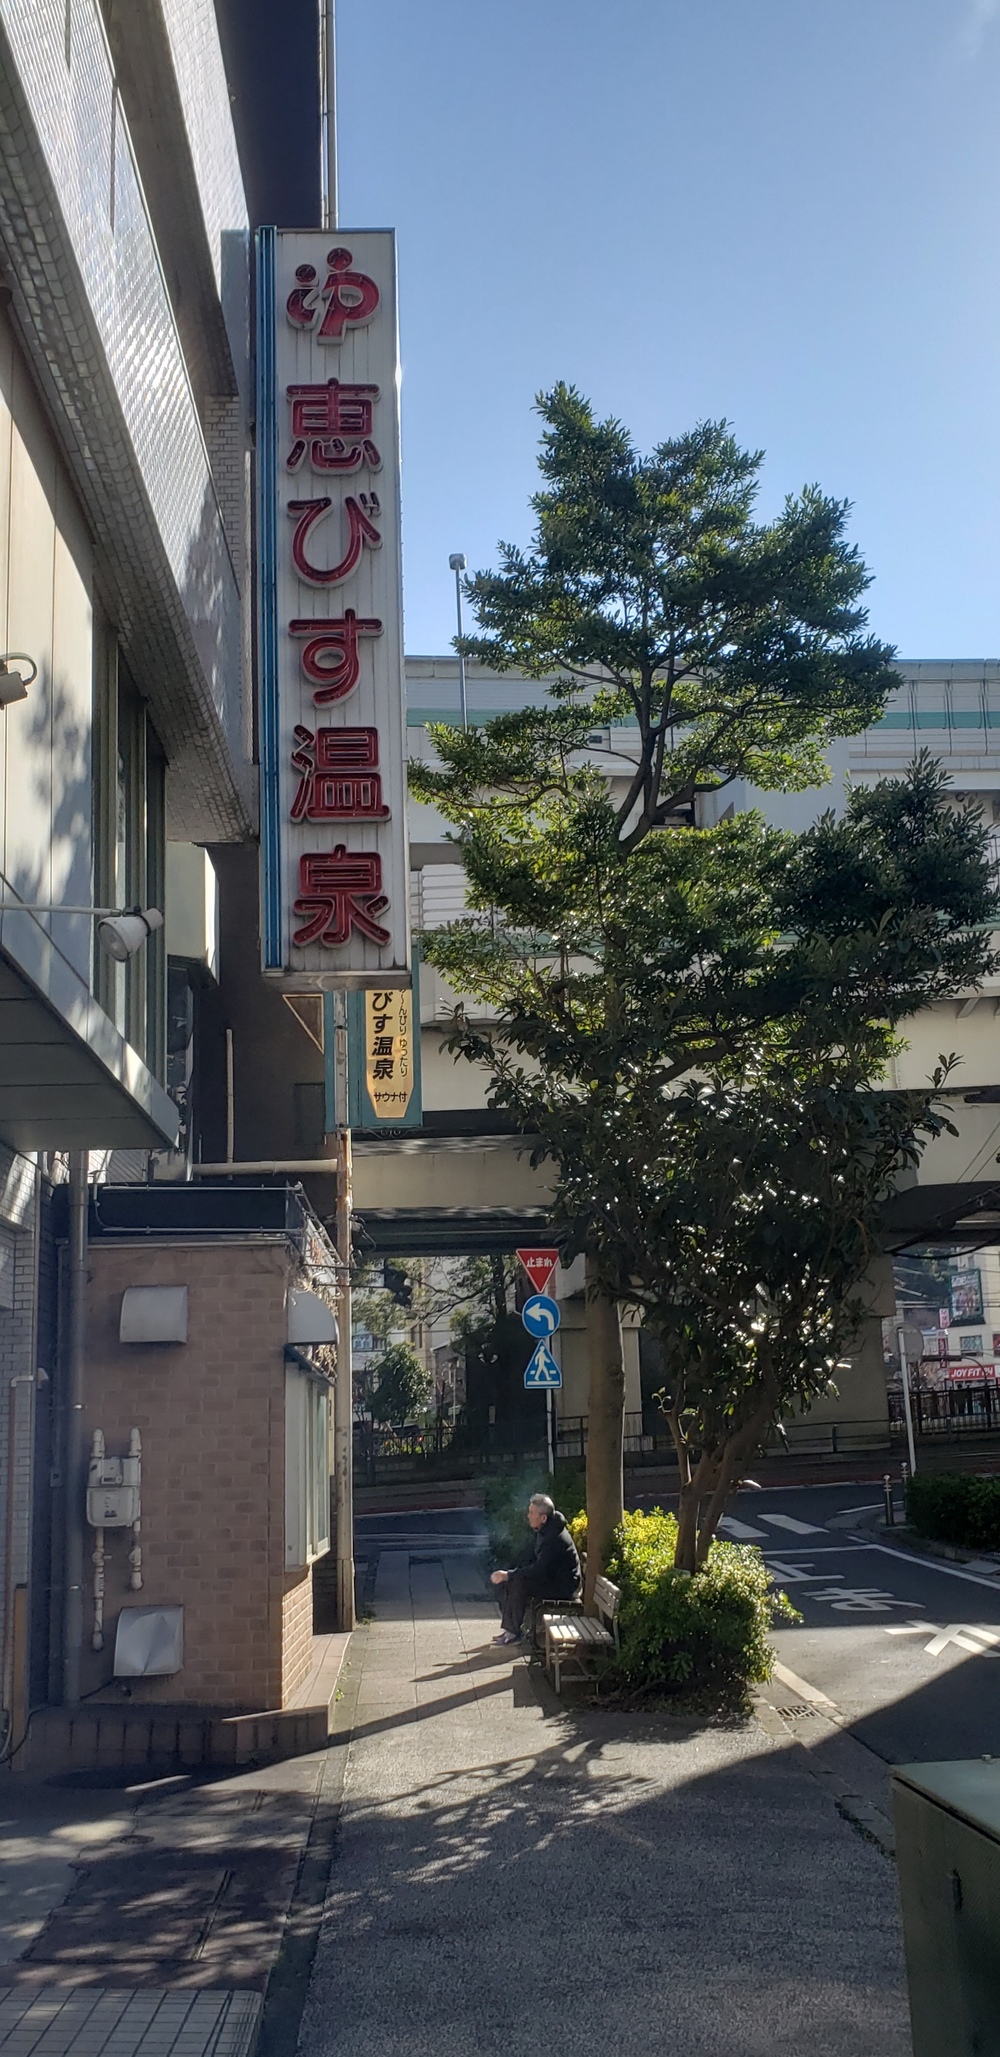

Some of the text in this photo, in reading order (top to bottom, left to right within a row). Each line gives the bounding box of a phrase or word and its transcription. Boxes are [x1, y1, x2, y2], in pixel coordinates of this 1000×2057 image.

[286, 377, 392, 948] 恵びす温泉
[373, 1091, 408, 1103] サウナ付
[527, 1257, 553, 1268] 止まれ
[951, 1368, 967, 1378] JOY
[967, 1368, 981, 1377] FIT
